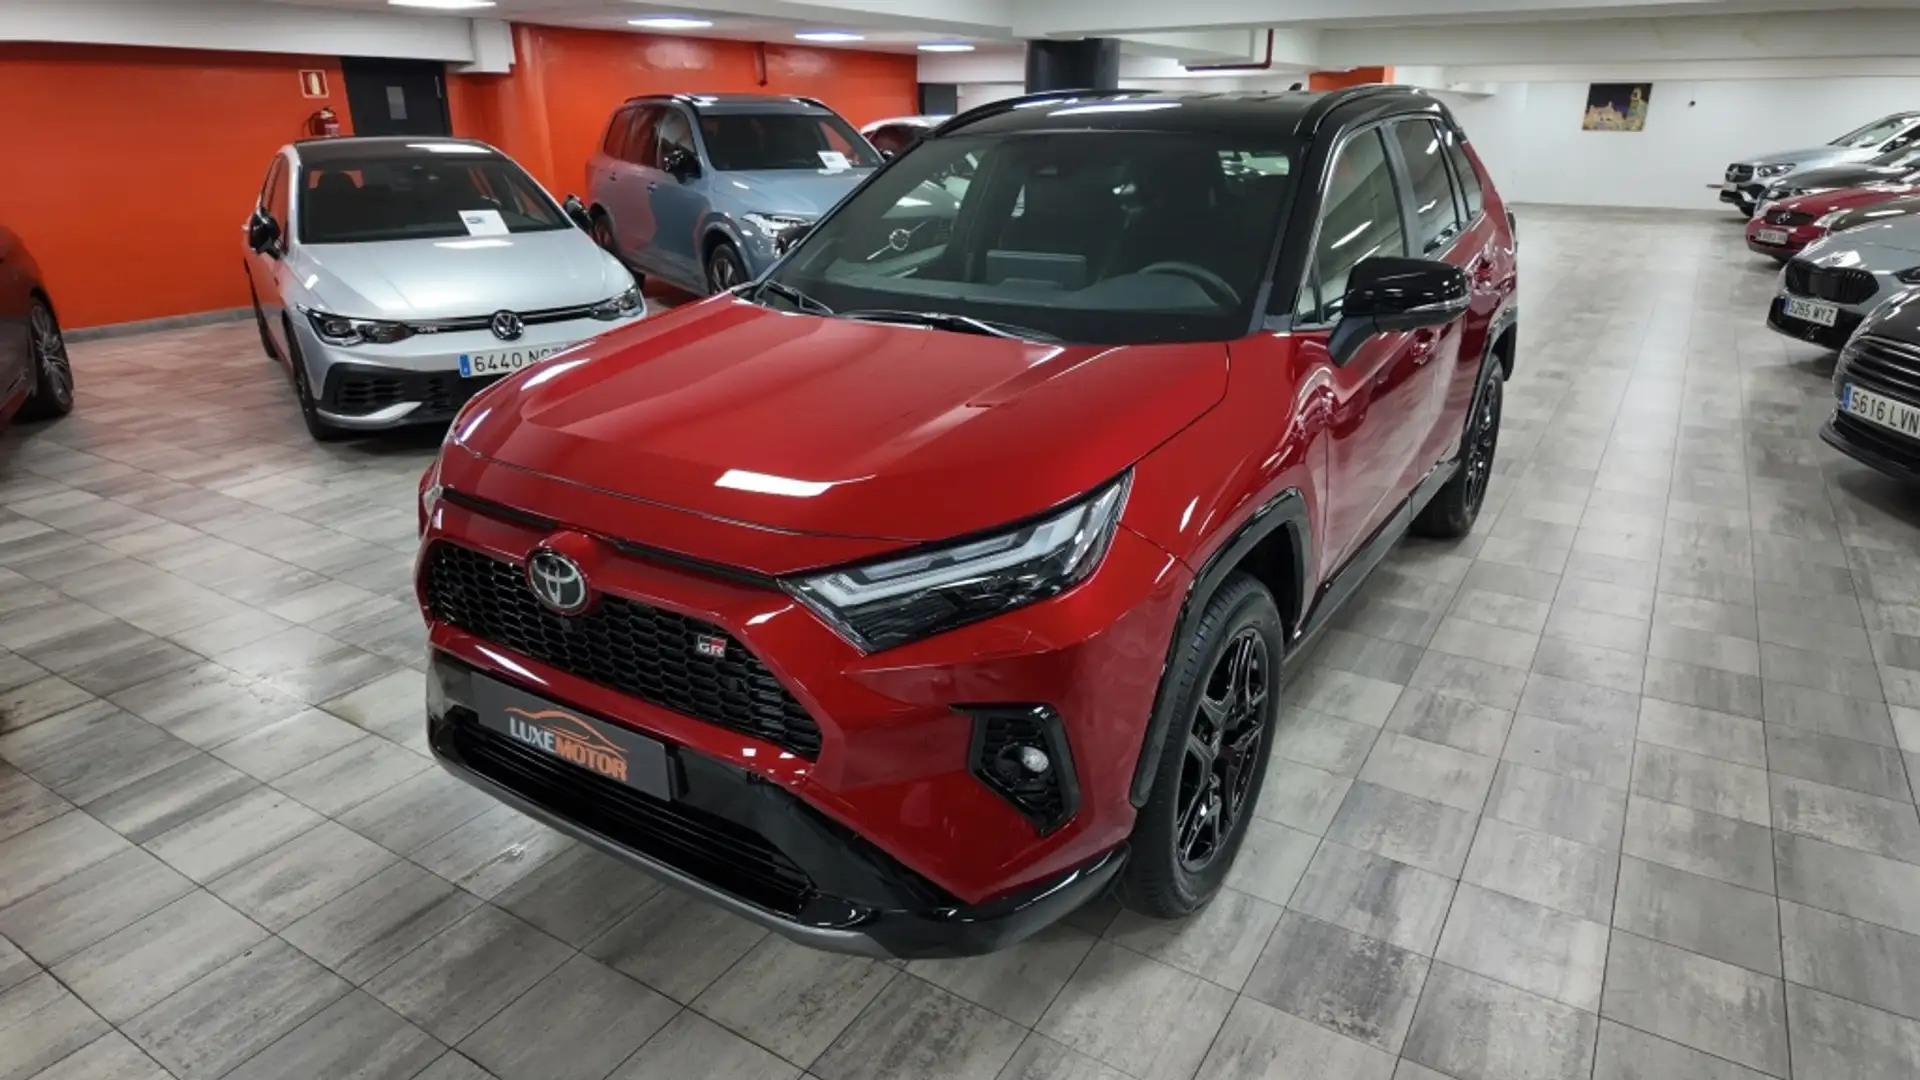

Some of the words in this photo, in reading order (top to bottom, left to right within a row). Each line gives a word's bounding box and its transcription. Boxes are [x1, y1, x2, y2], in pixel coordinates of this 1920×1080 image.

[474, 352, 522, 372] 6440
[1852, 391, 1886, 421] 5616
[1889, 404, 1920, 434] LVN
